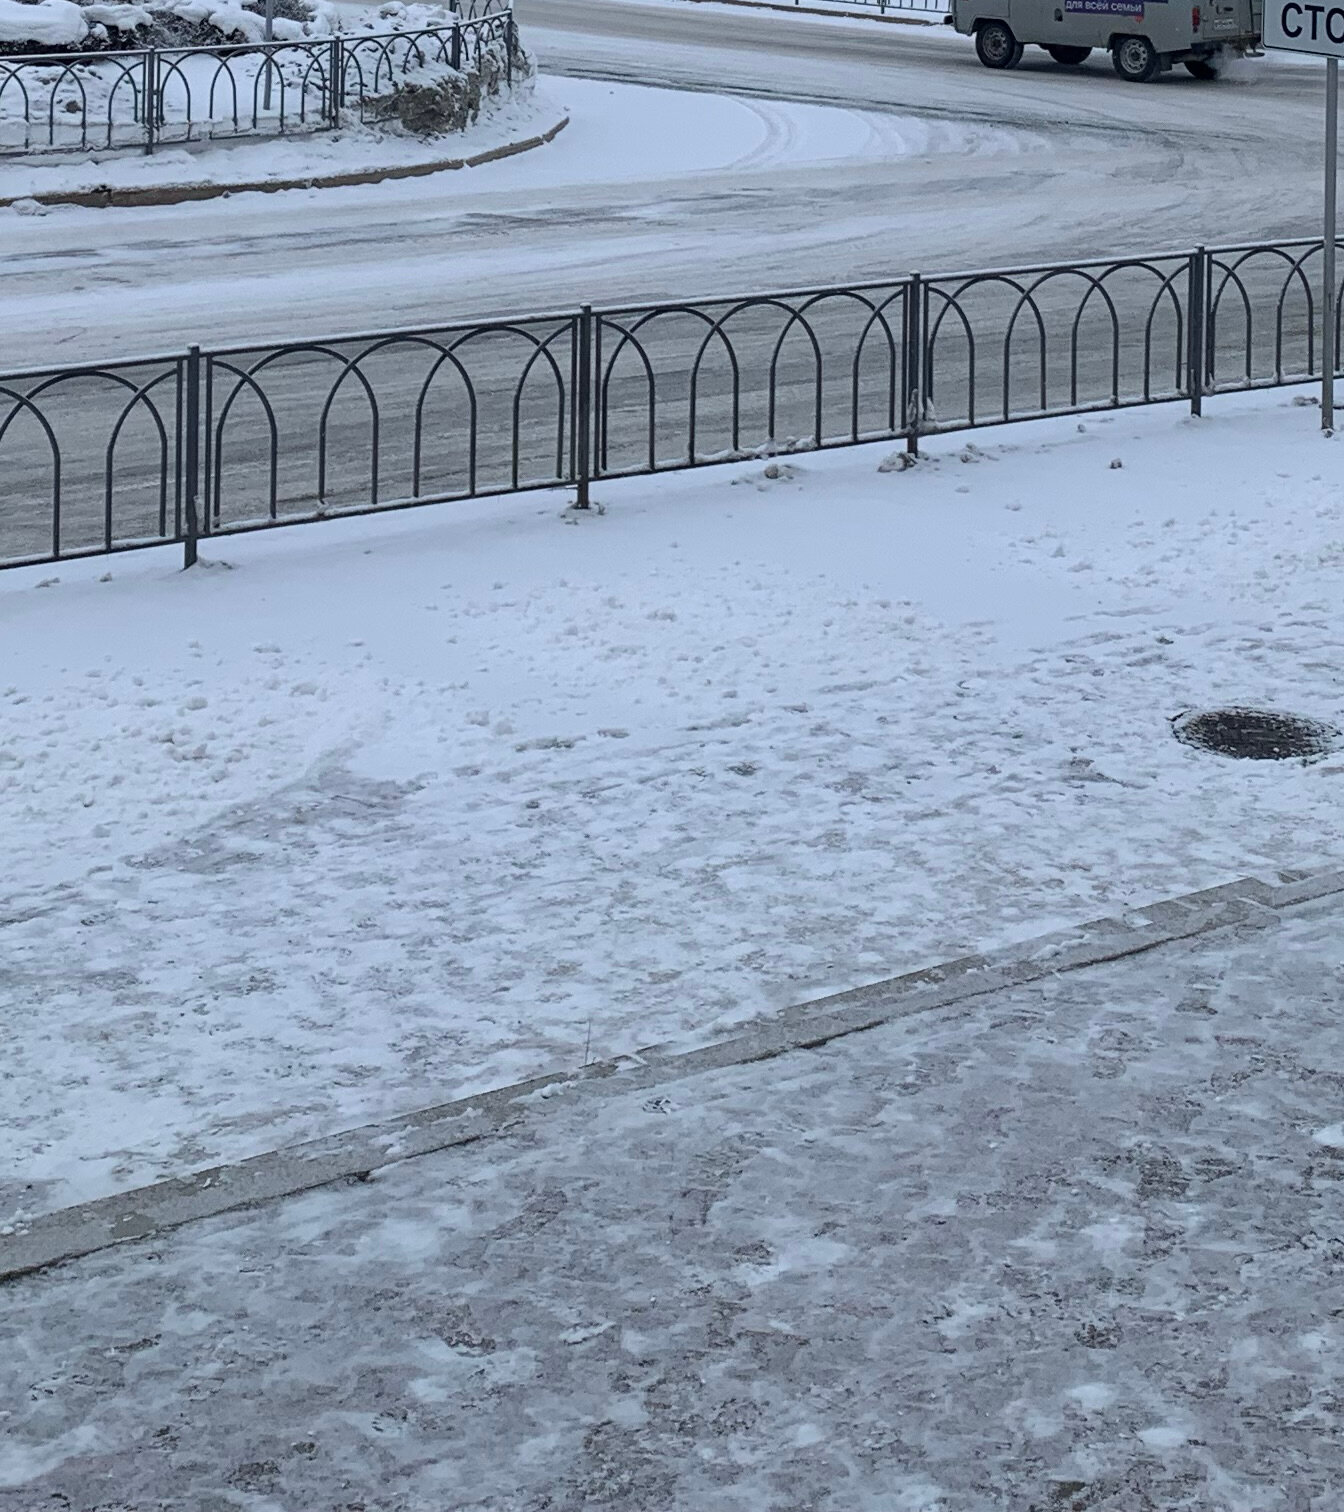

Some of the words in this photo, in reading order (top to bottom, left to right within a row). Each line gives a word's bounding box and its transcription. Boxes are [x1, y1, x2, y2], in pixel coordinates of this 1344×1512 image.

[1066, 1, 1083, 9] для
[1085, 1, 1109, 10] всей
[1111, 3, 1142, 12] семьи
